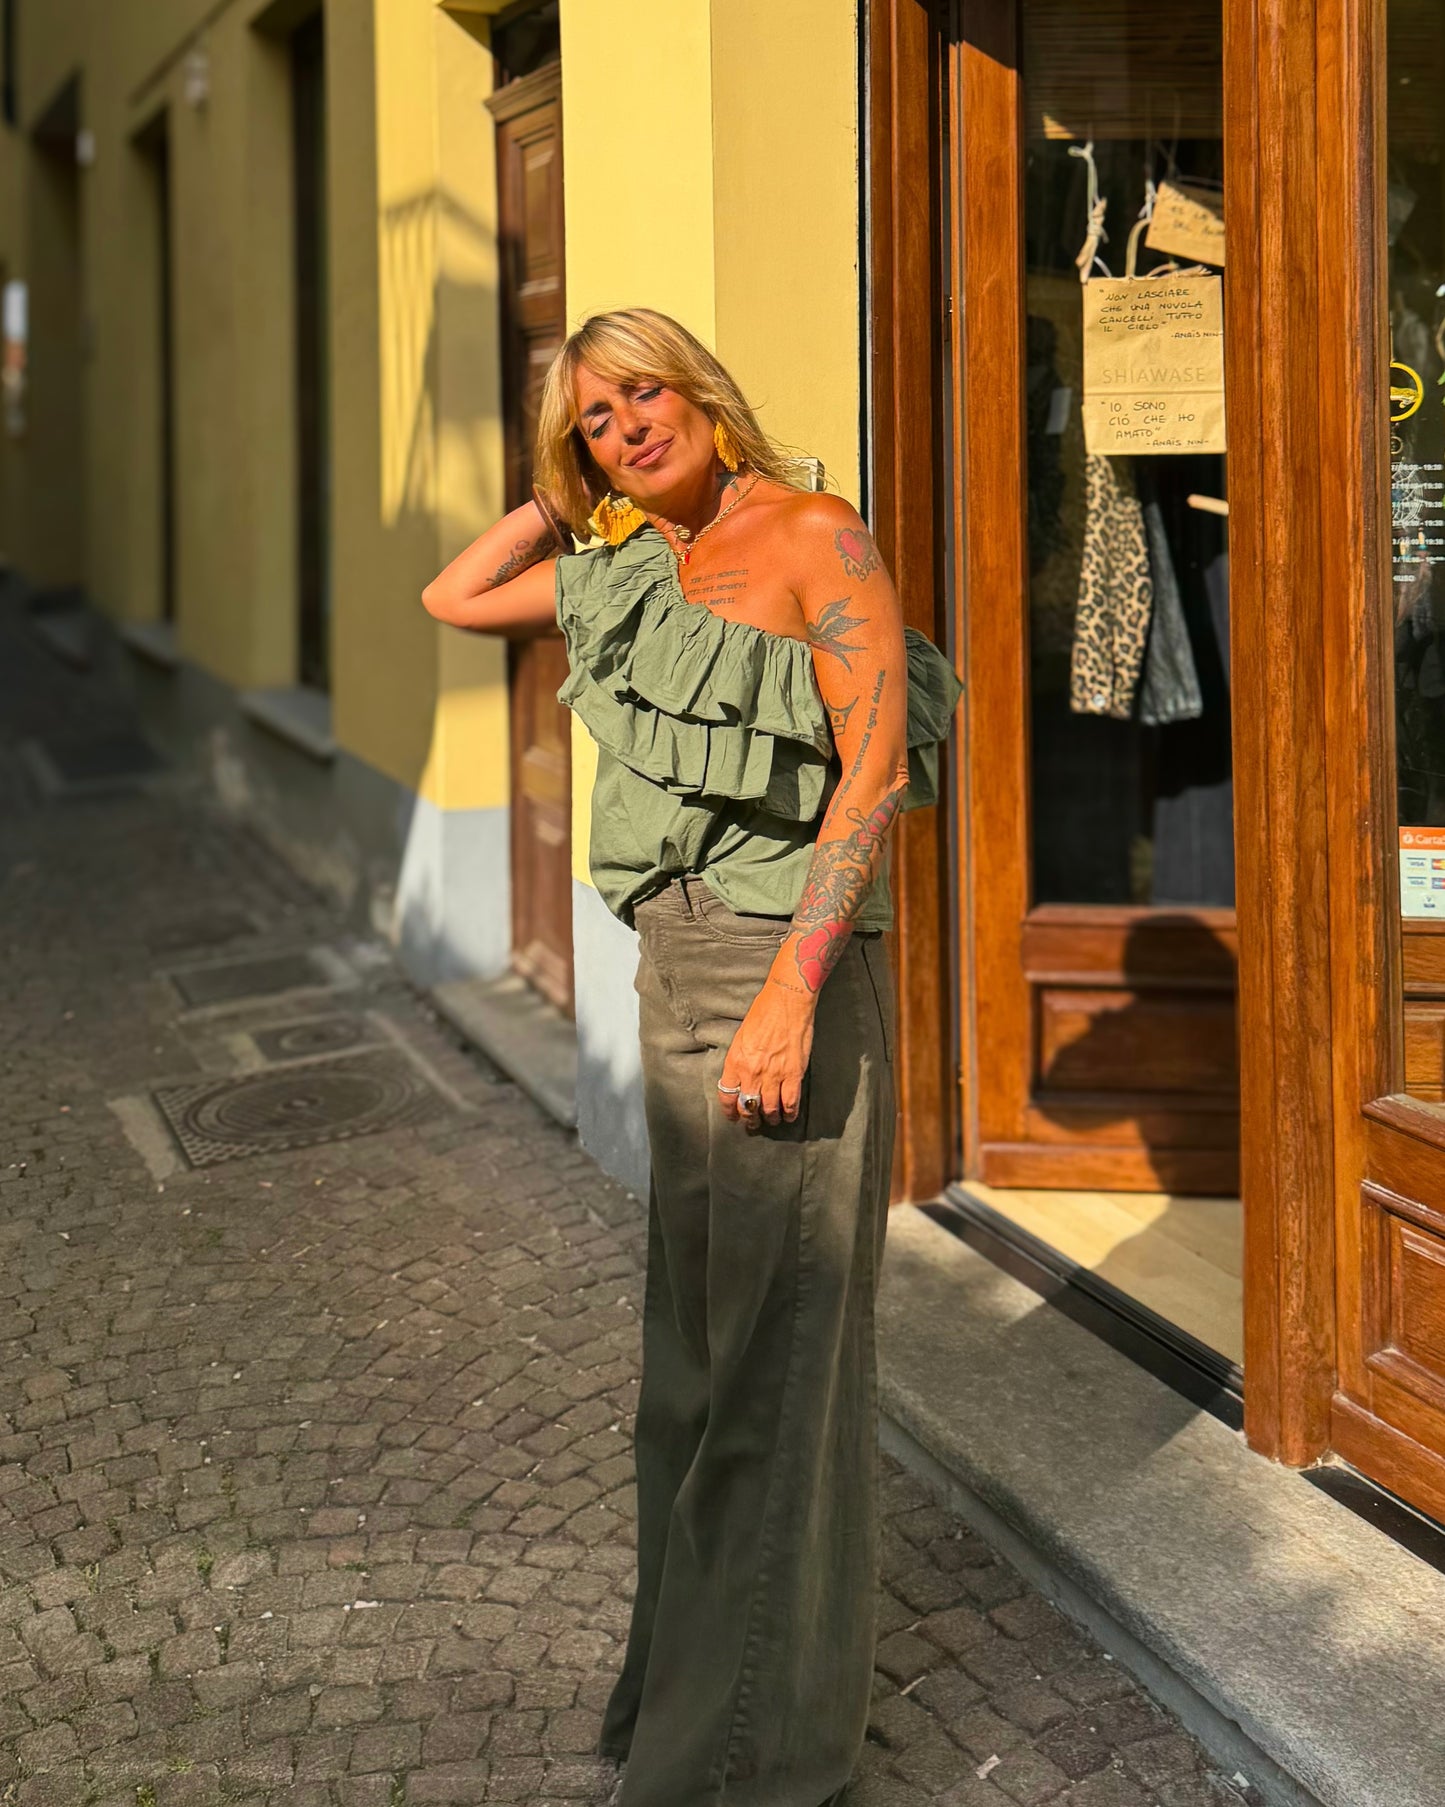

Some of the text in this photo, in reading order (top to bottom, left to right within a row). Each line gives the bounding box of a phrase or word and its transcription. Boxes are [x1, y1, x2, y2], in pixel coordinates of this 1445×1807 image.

[1137, 289, 1190, 299] LASCIARE
[1100, 305, 1122, 313] CHE
[1130, 303, 1150, 311] UNA
[1102, 367, 1206, 384] SHIAWASE
[1133, 401, 1167, 412] SONO
[1143, 415, 1166, 424] CHE
[1178, 413, 1195, 422] HO
